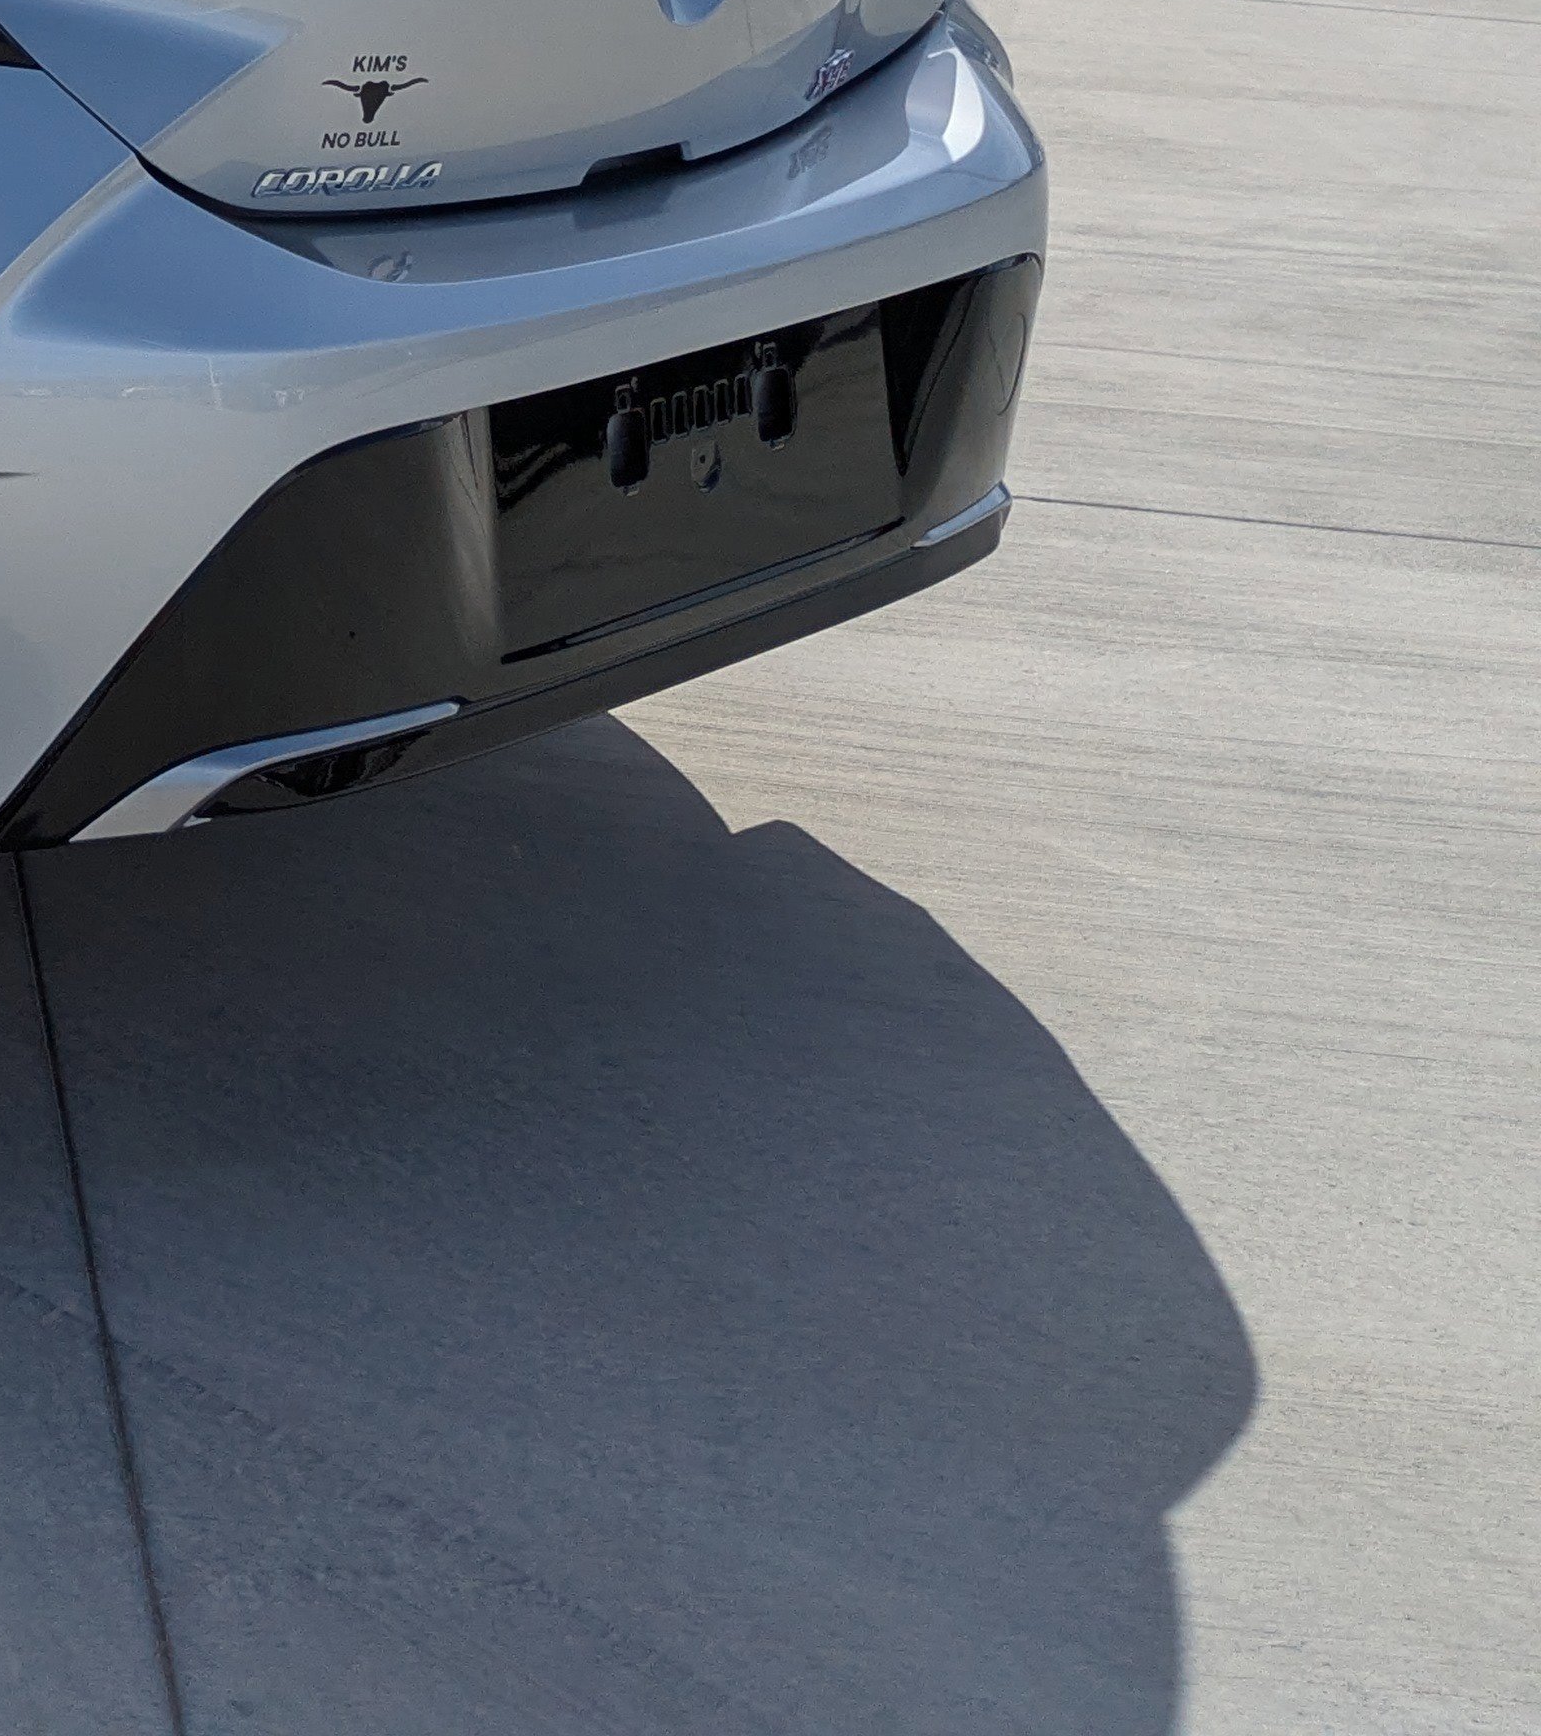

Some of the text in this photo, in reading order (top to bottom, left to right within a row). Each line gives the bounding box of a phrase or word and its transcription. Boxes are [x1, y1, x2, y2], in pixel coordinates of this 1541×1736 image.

[352, 55, 408, 72] KIM'S
[321, 130, 401, 149] NO BULL
[251, 161, 443, 198] COROLLA
